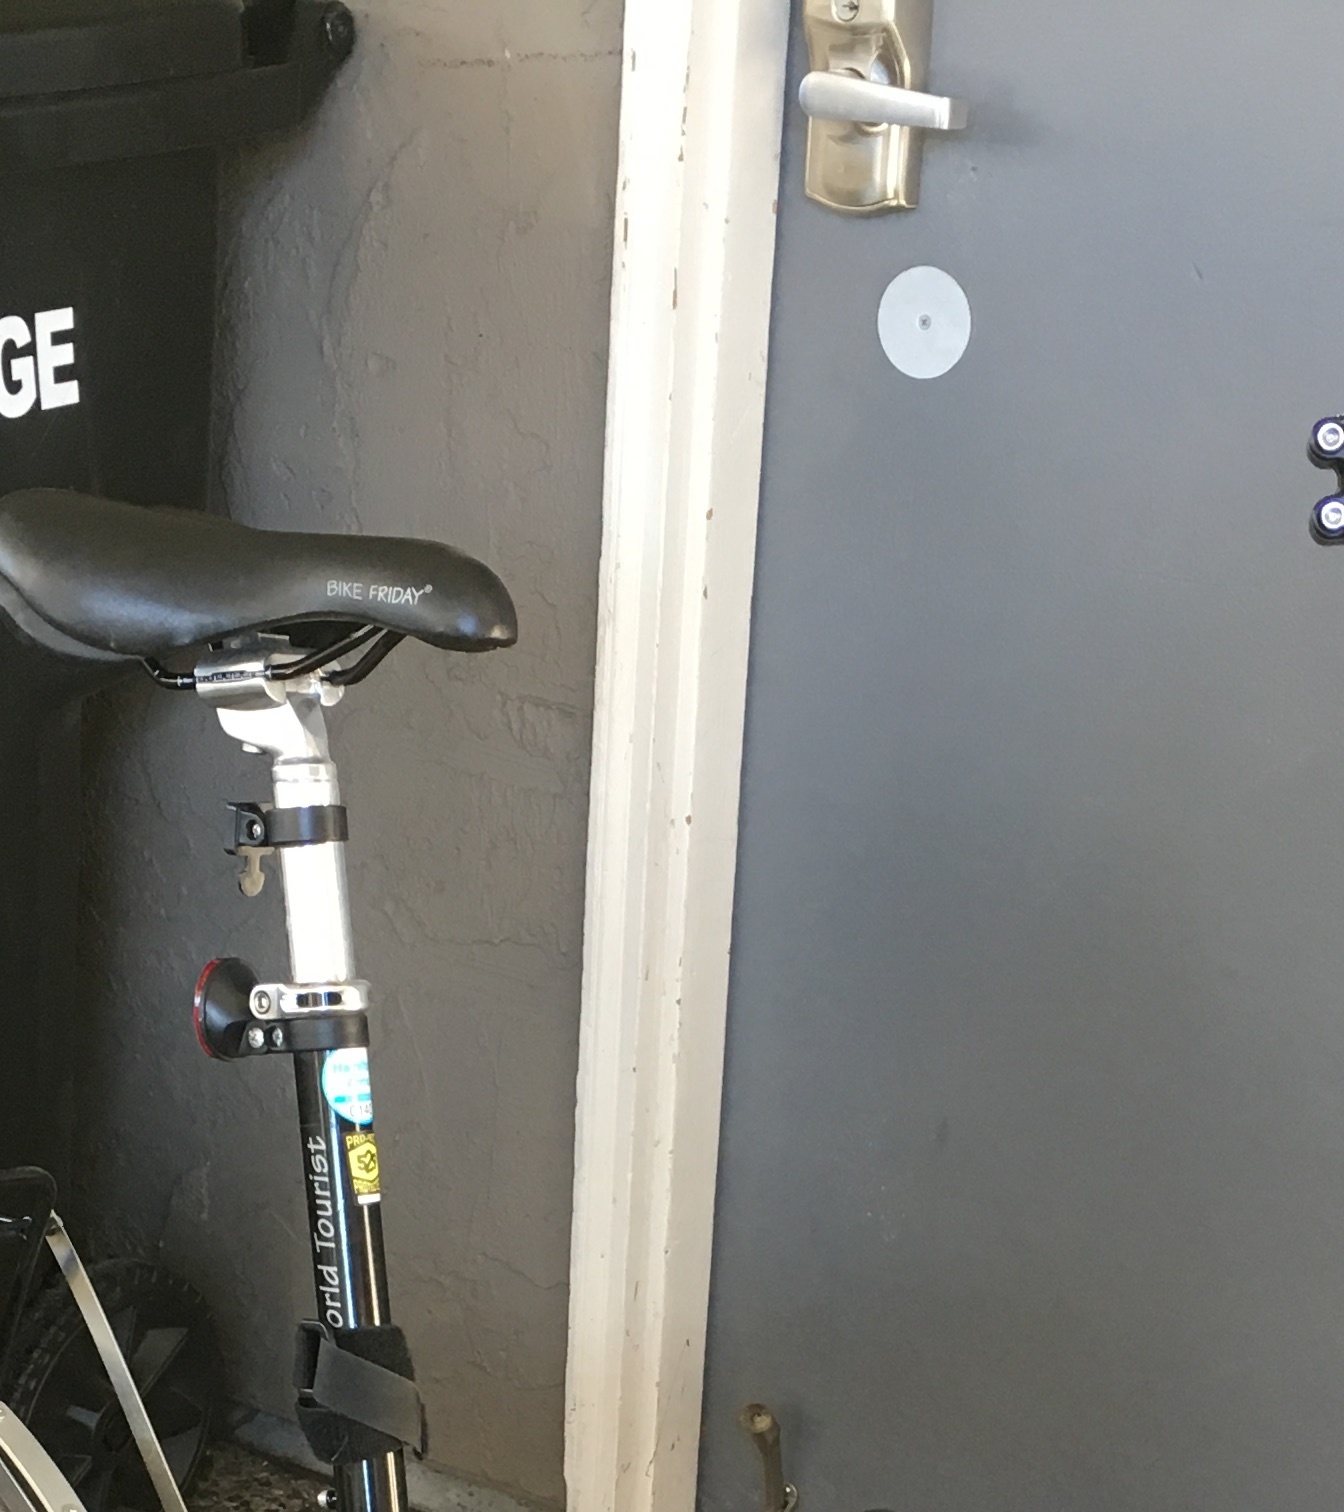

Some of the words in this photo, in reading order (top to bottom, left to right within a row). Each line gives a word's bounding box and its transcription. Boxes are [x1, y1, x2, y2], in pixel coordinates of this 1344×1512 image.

[326, 580, 363, 600] BIKE
[369, 585, 424, 605] FRIDAY
[307, 1135, 336, 1253] Tourist
[317, 1264, 343, 1328] orld
